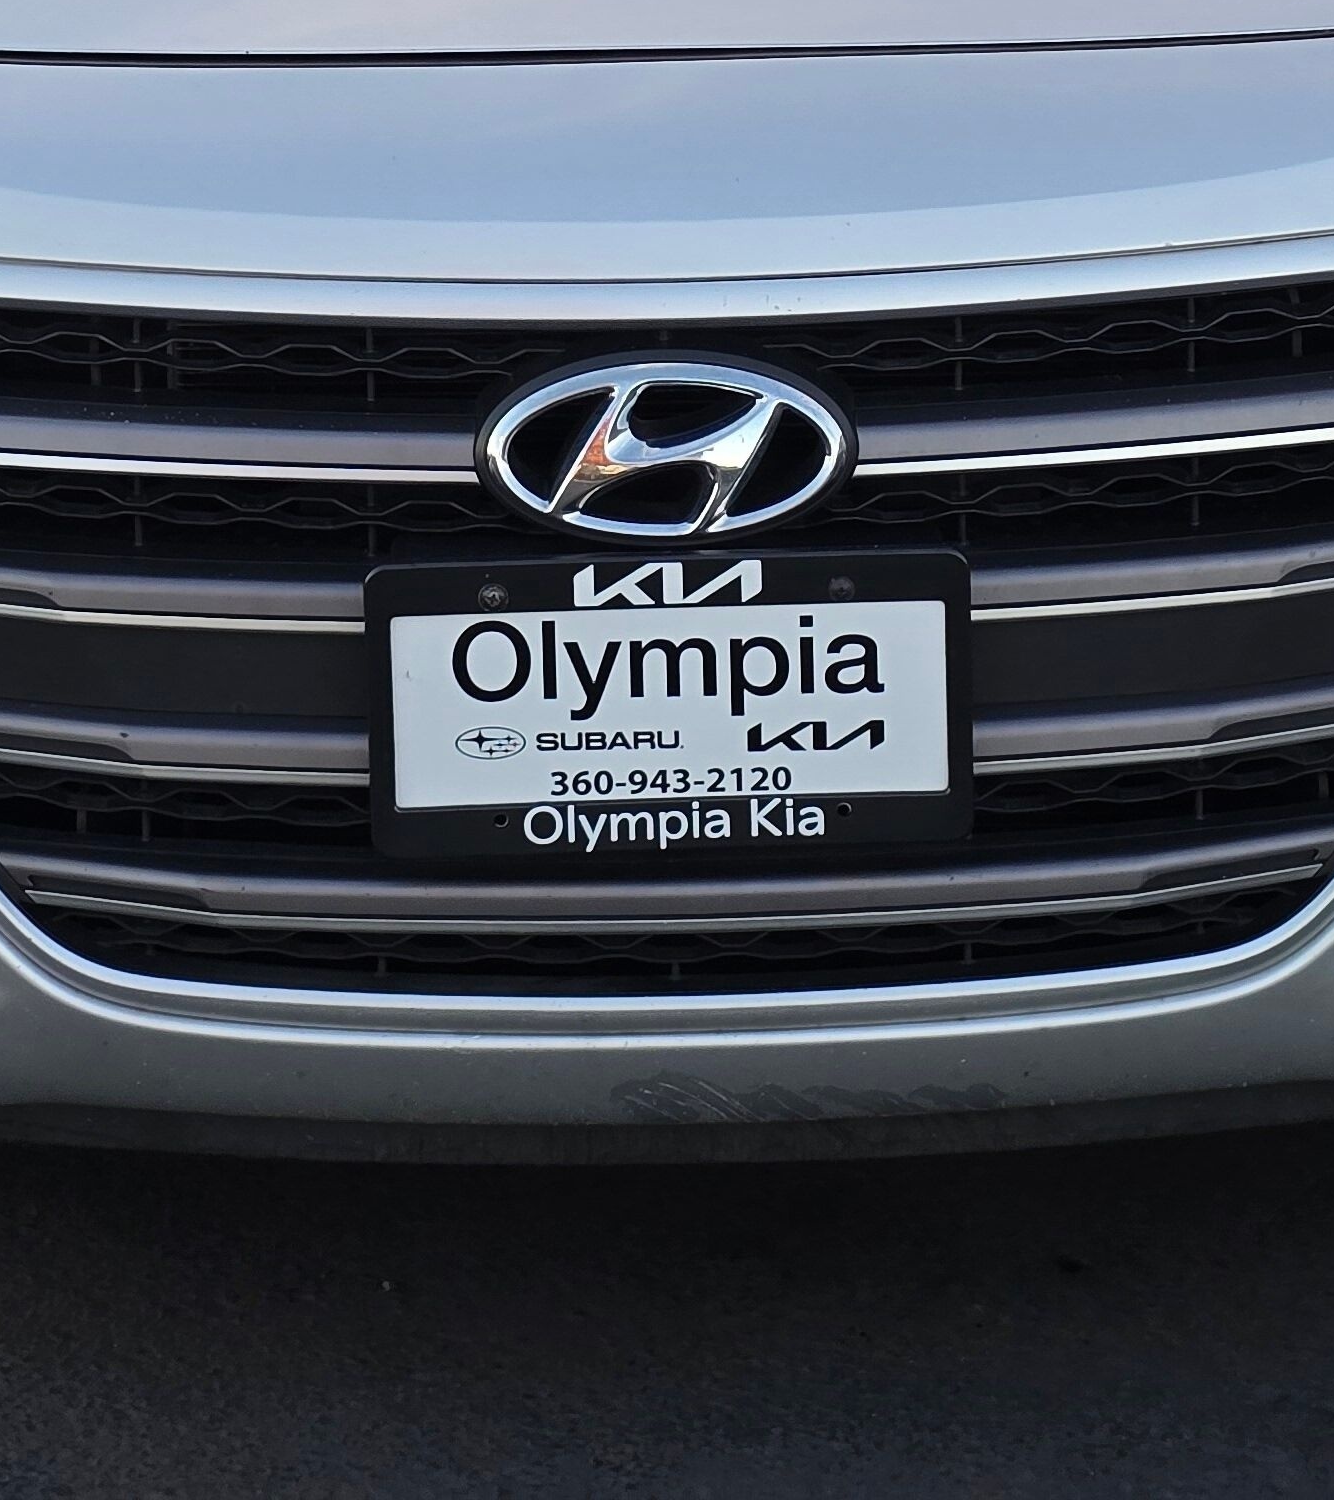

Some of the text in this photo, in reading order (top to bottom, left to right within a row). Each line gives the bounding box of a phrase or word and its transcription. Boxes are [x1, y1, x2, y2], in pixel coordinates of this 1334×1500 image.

[573, 559, 763, 608] KIA
[452, 615, 885, 721] Olympia
[535, 730, 681, 752] SUBARU
[747, 720, 885, 753] KIA
[550, 766, 792, 796] 360-943-2120
[523, 798, 826, 853] Olympia Kia
